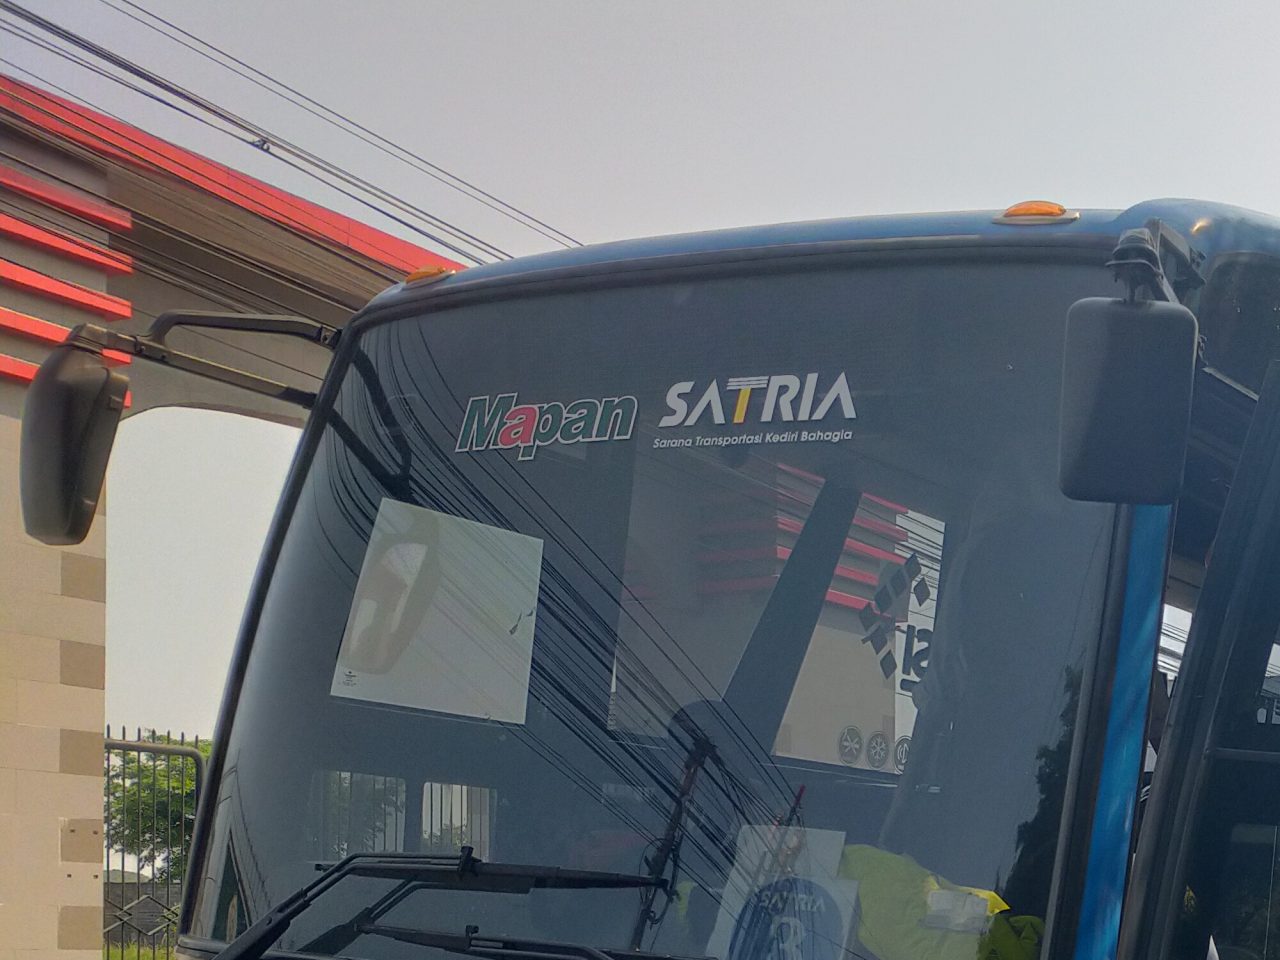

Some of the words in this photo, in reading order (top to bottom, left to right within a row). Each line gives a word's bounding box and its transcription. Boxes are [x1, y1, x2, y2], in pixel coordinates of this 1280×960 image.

[455, 392, 638, 461] Mapan
[658, 371, 857, 427] SATRIA
[652, 437, 692, 449] Sarana
[696, 434, 763, 447] Transportasi
[765, 431, 798, 443] Kediri
[801, 429, 853, 442] Bahagia
